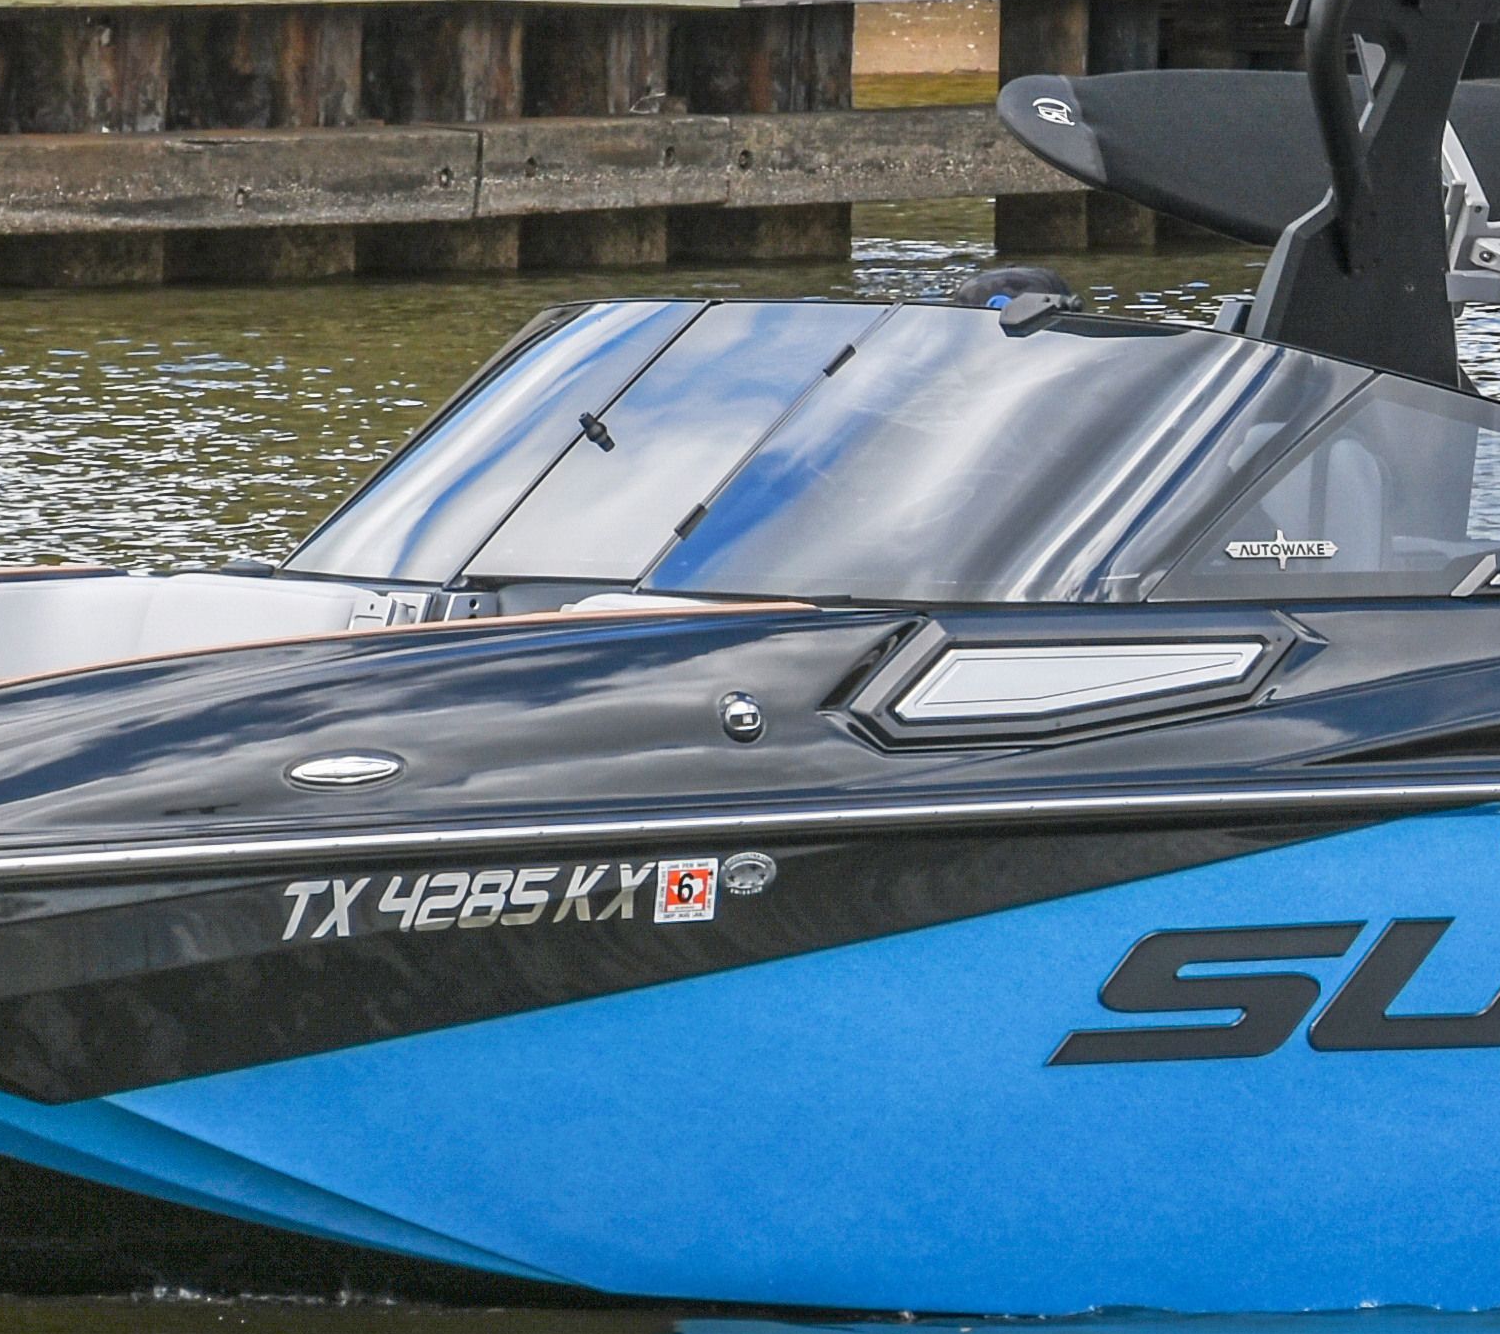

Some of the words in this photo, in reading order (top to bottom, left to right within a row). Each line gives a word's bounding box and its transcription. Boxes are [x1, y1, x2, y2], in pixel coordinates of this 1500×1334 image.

[1239, 543, 1326, 556] AUTOWAKE
[281, 877, 371, 941] TX
[378, 867, 560, 933] 4285
[553, 862, 656, 923] KX
[677, 873, 695, 903] 6
